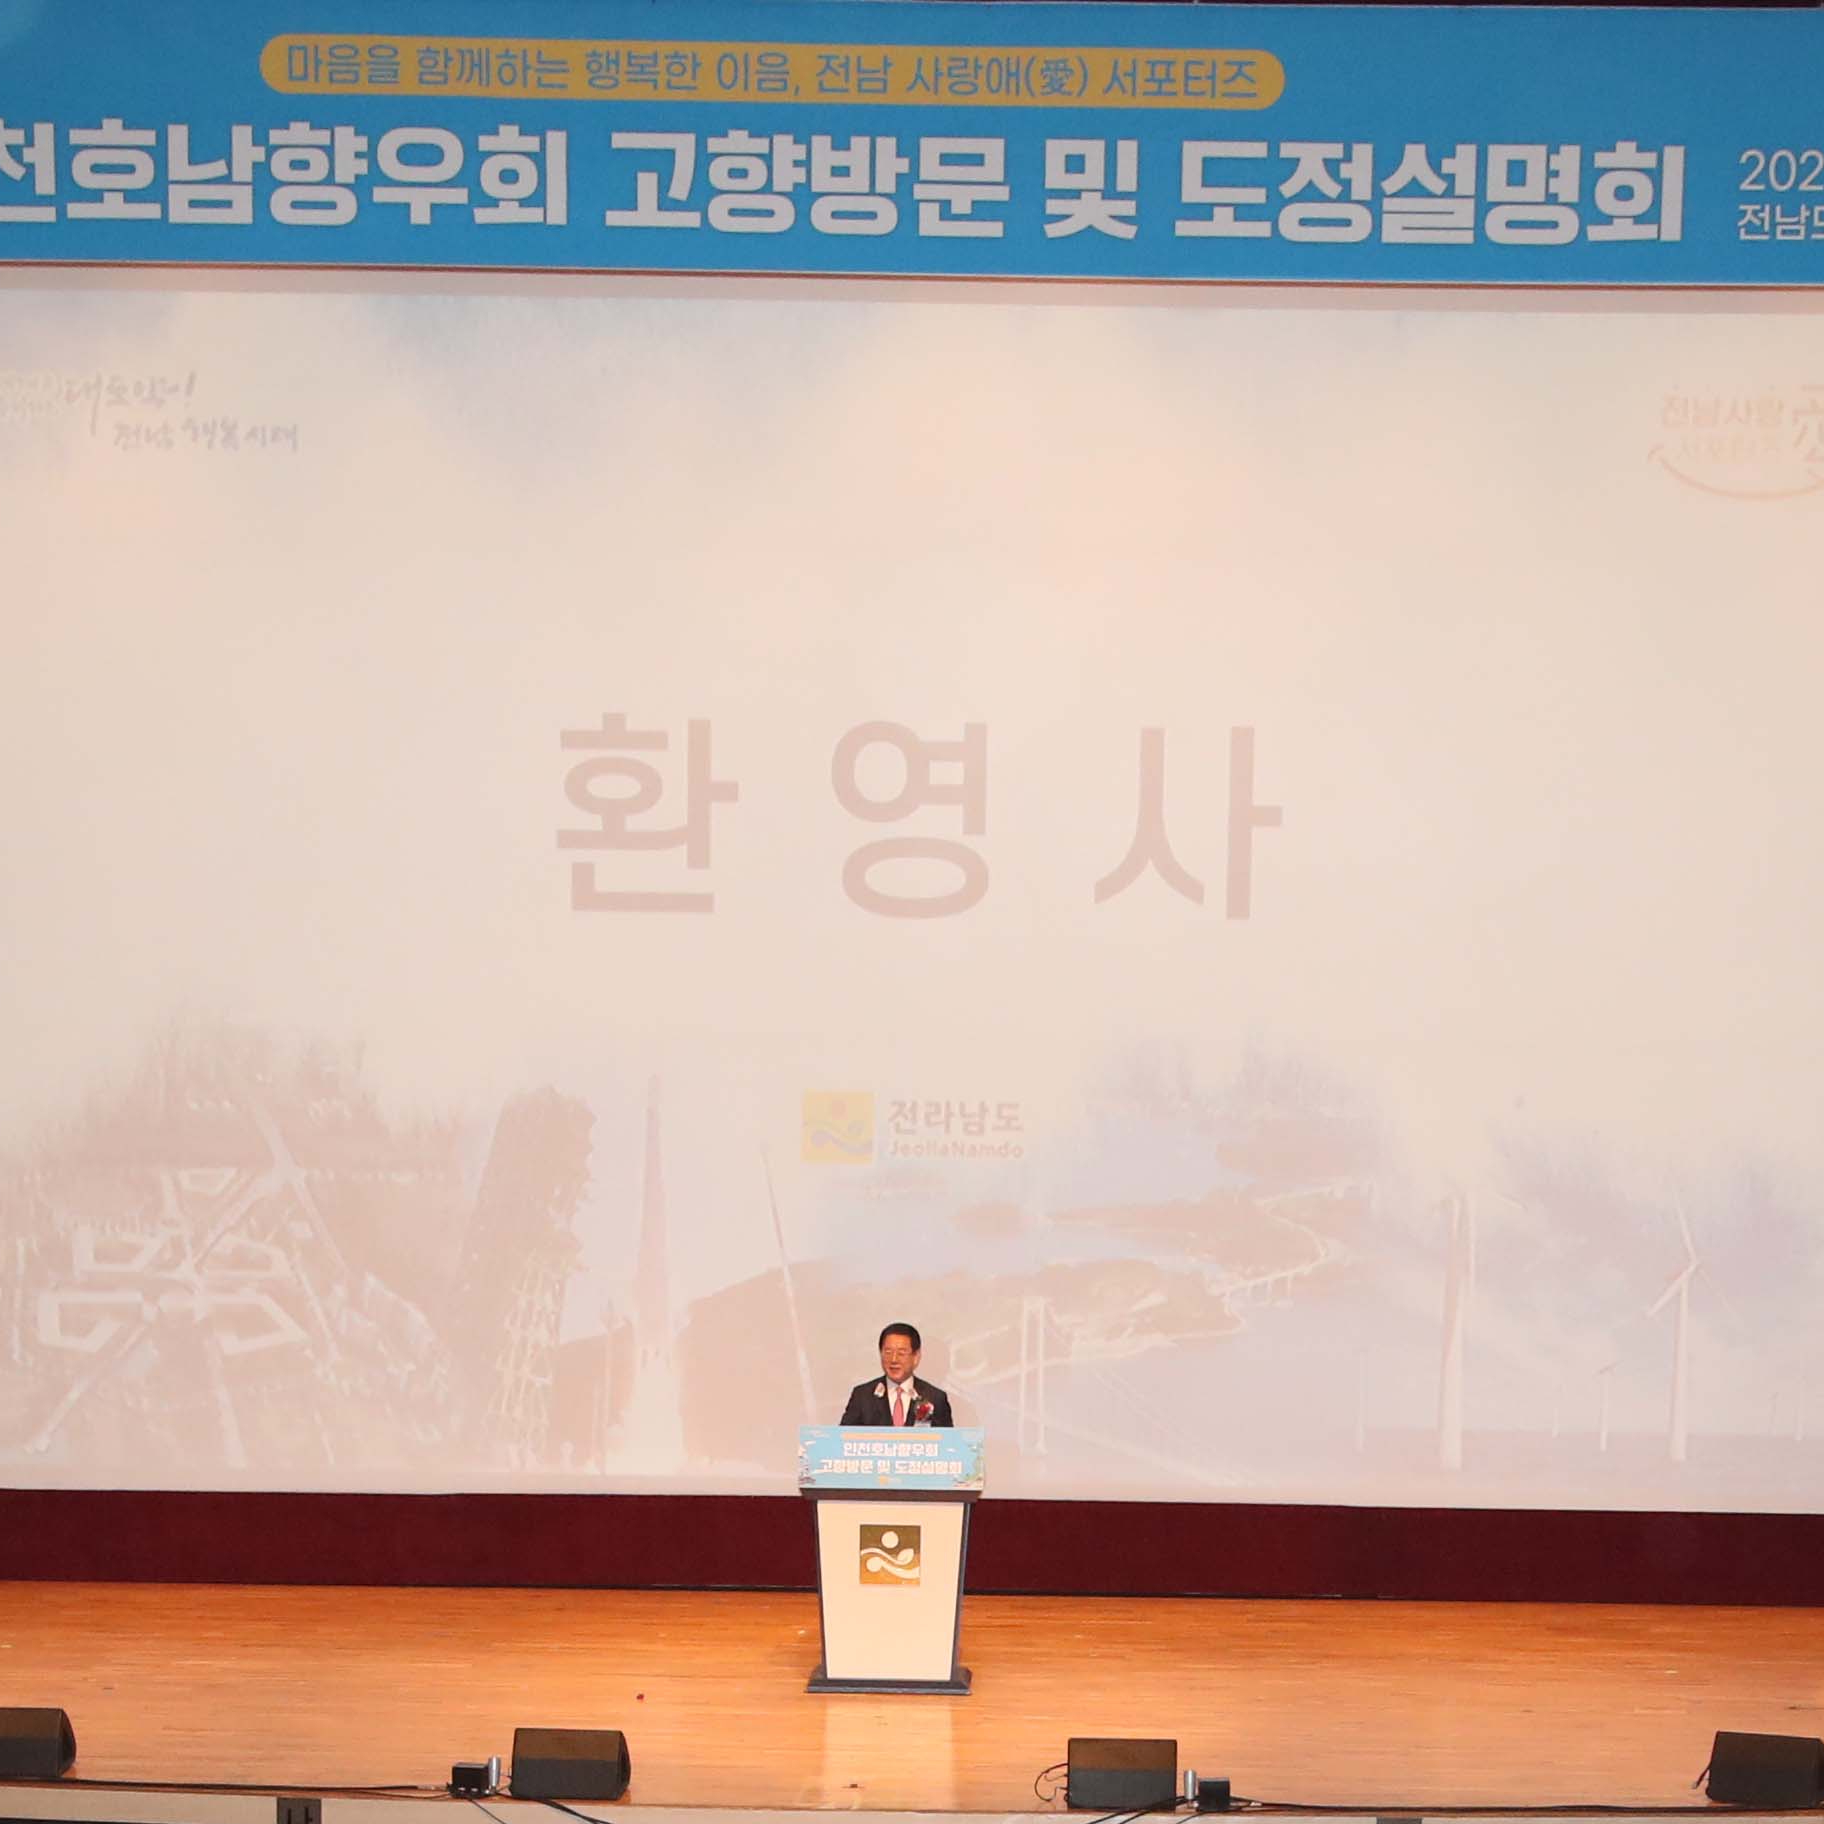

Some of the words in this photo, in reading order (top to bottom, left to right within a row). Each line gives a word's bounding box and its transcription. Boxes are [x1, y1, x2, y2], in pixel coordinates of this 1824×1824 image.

[286, 43, 401, 85] 마음을
[416, 46, 570, 90] 함께하는
[584, 50, 703, 92] 행복한
[715, 51, 802, 97] 이음,
[814, 53, 894, 95] 전남
[905, 54, 1088, 99] 사랑애(愛)
[1102, 57, 1259, 100] 서포터즈
[604, 129, 1010, 239] 고향방문
[1043, 138, 1139, 240] 및
[1175, 140, 1686, 245] 도정설명회
[887, 1100, 1025, 1137] 전라남도
[889, 1139, 1025, 1160] JeollaNamdo
